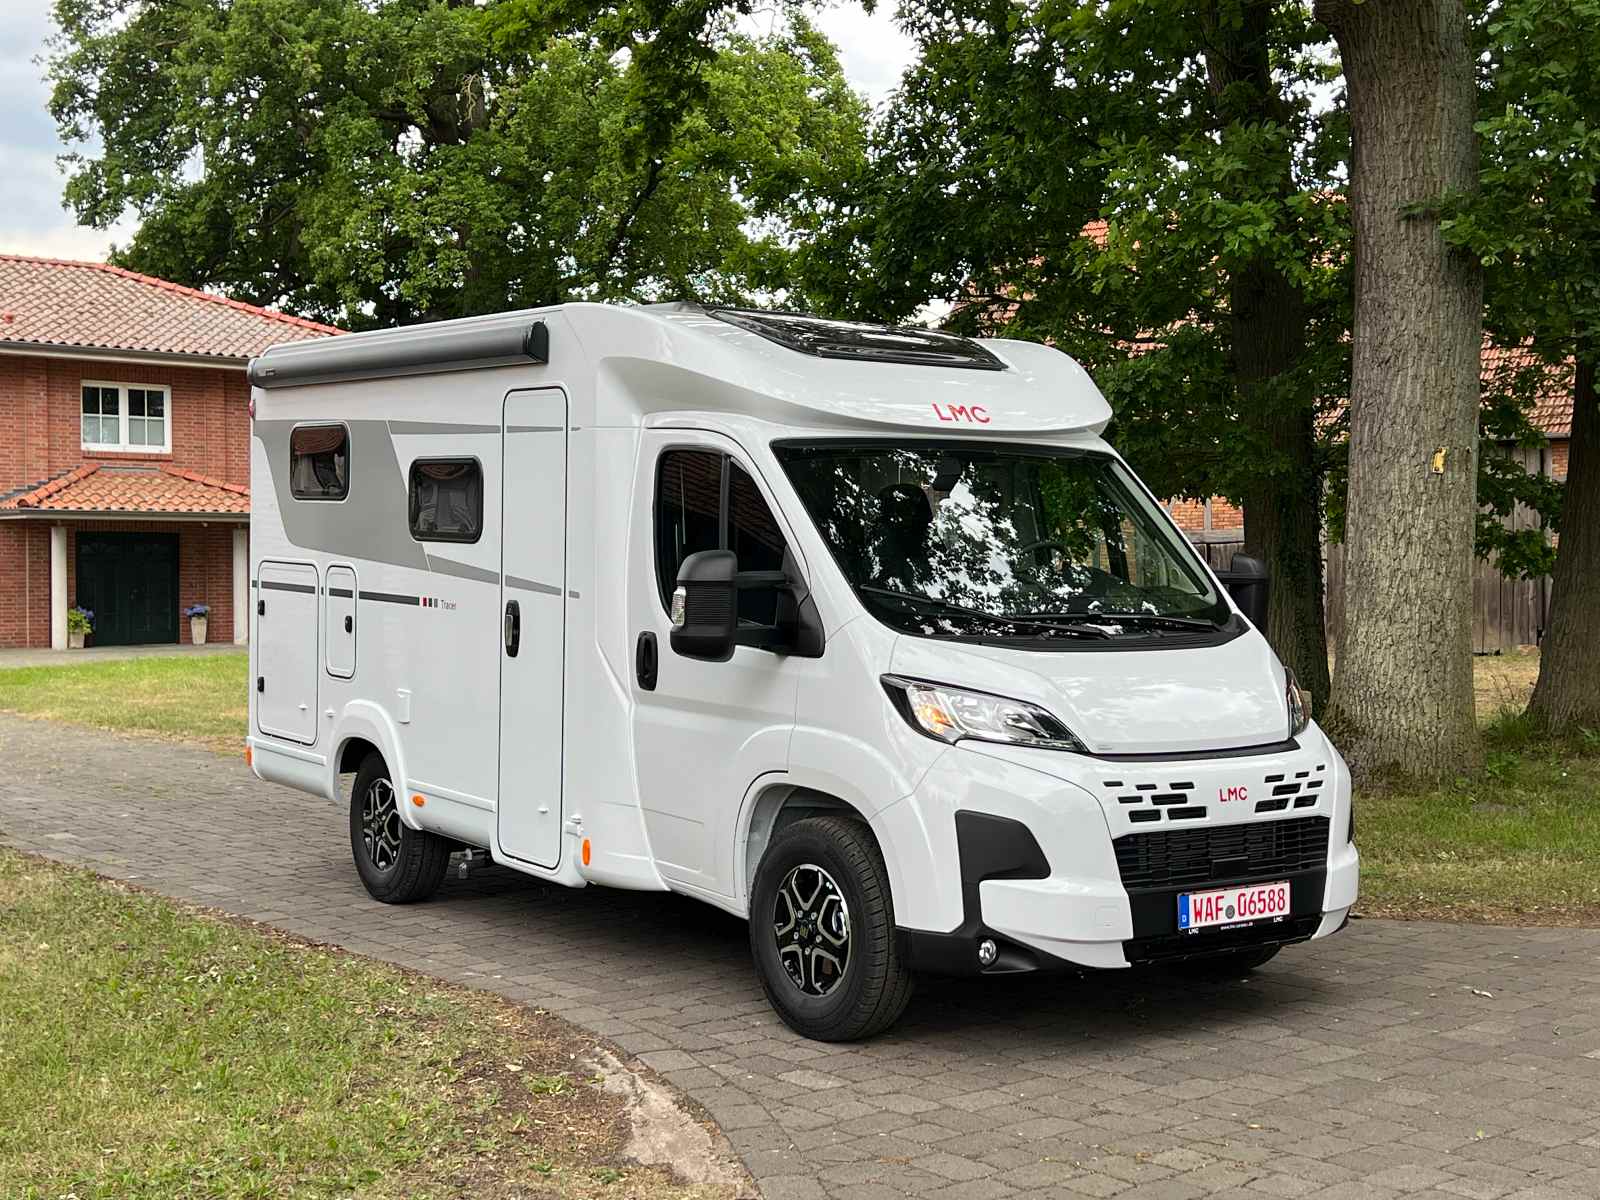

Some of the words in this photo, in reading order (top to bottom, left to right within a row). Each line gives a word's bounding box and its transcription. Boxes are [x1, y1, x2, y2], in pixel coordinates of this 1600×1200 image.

[932, 403, 990, 423] LMC
[1219, 786, 1247, 802] LMC
[1193, 895, 1225, 923] WAF
[1237, 888, 1285, 917] 06588
